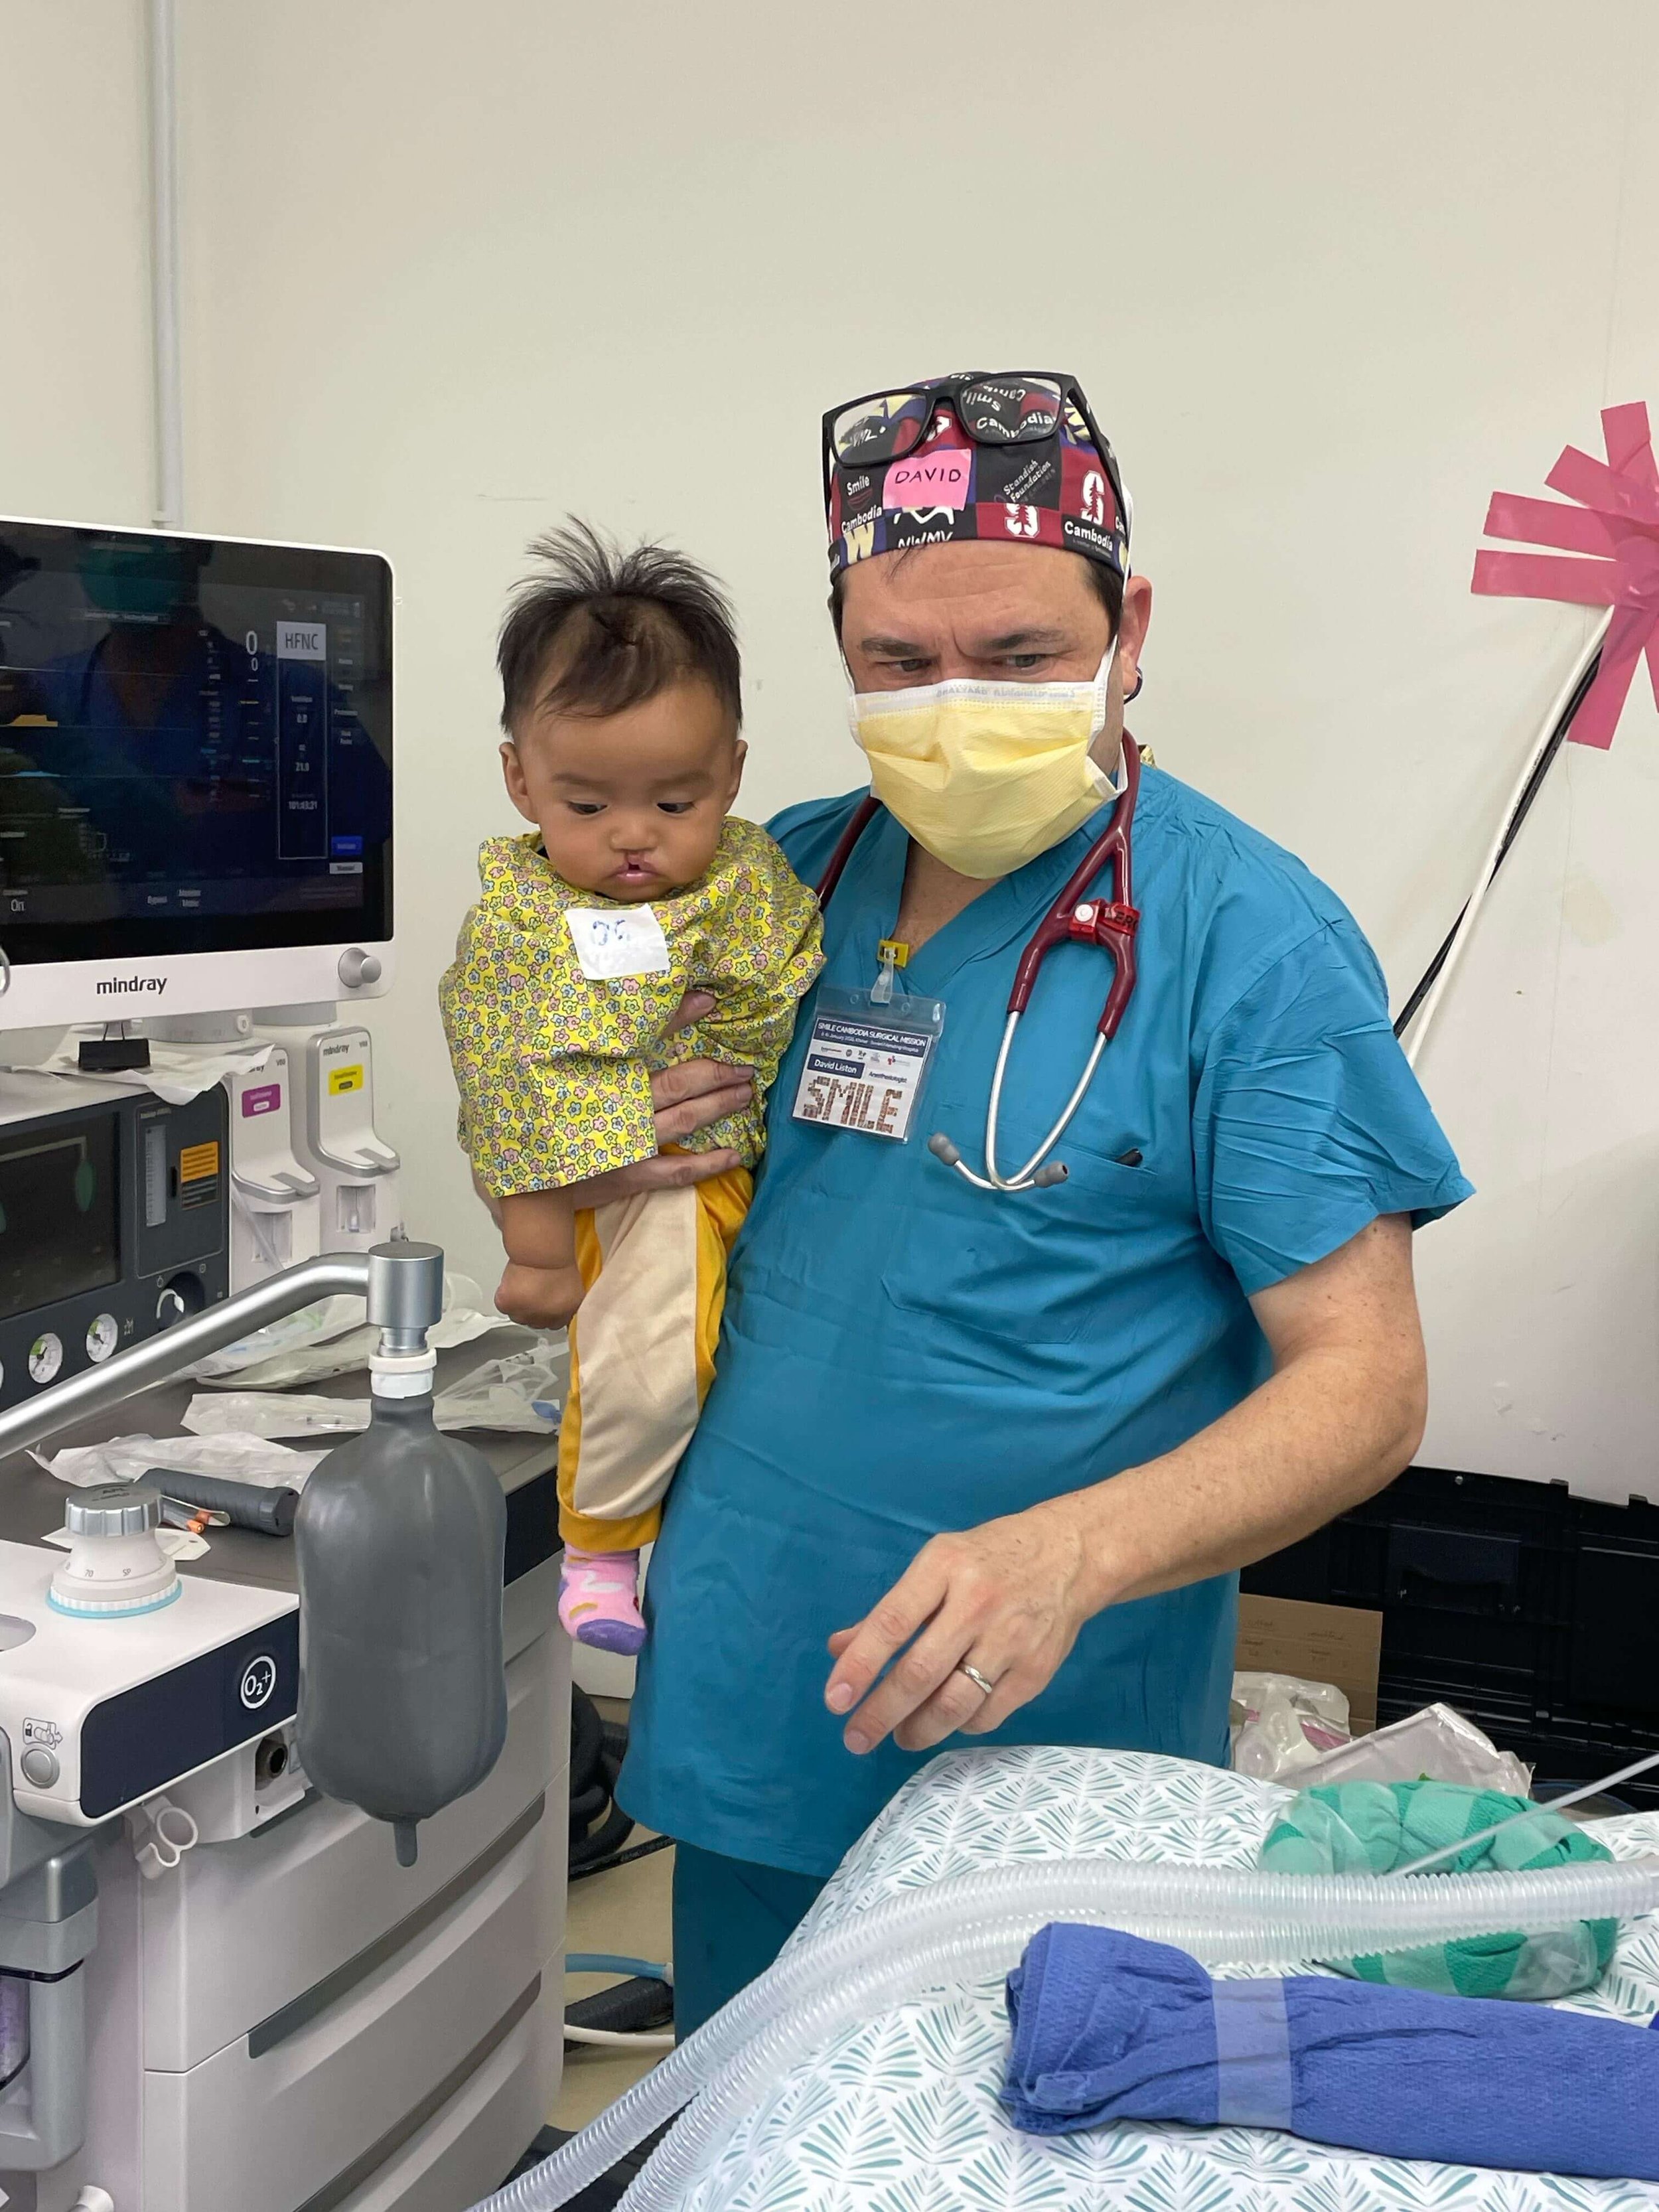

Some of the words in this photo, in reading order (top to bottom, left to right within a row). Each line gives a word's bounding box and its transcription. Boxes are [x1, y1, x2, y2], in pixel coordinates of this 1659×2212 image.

[847, 475, 870, 496] Smile
[895, 467, 962, 484] DAVID
[1003, 459, 1039, 495] Standish
[1010, 461, 1051, 502] Foundation
[841, 505, 883, 534] Cambodia
[1064, 521, 1113, 552] Cambodia
[246, 631, 257, 655] 0
[285, 632, 319, 650] HFNC
[11, 899, 25, 912] On
[96, 976, 167, 995] mindray
[818, 1022, 835, 1032] SMILE
[835, 1025, 869, 1037] CAMBODIA
[869, 1031, 899, 1043] SURGICAL
[900, 1036, 926, 1047] MISSION
[814, 1059, 833, 1070] David
[835, 1063, 857, 1074] Liston
[802, 1076, 902, 1134] SMILE
